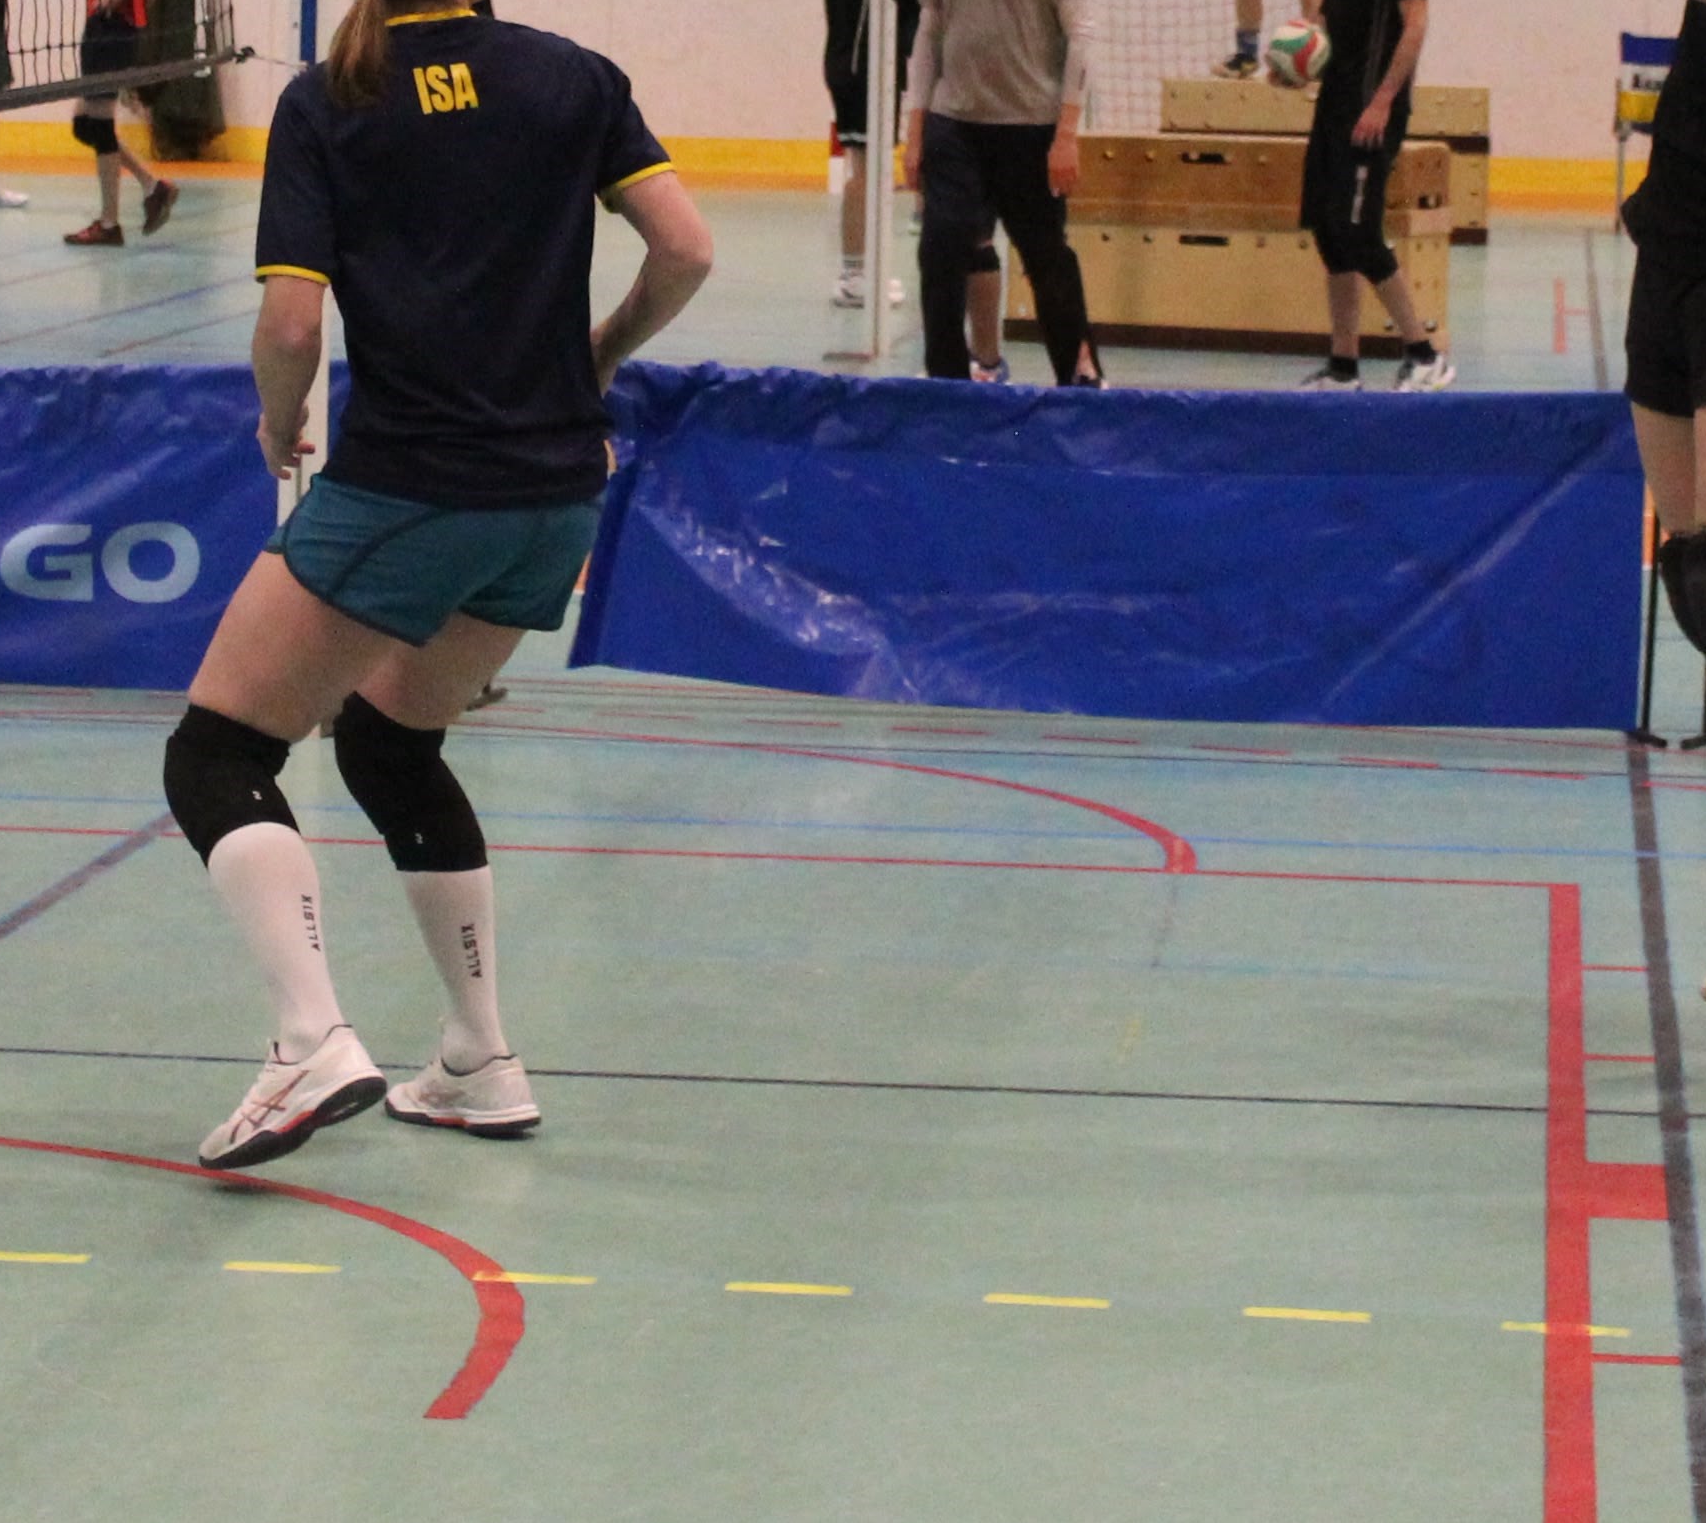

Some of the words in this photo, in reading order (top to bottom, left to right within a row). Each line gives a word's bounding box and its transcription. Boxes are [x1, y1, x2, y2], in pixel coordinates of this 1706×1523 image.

[413, 63, 478, 115] ISA
[301, 894, 321, 952] ALLSIX
[460, 923, 483, 978] ALLSIX
